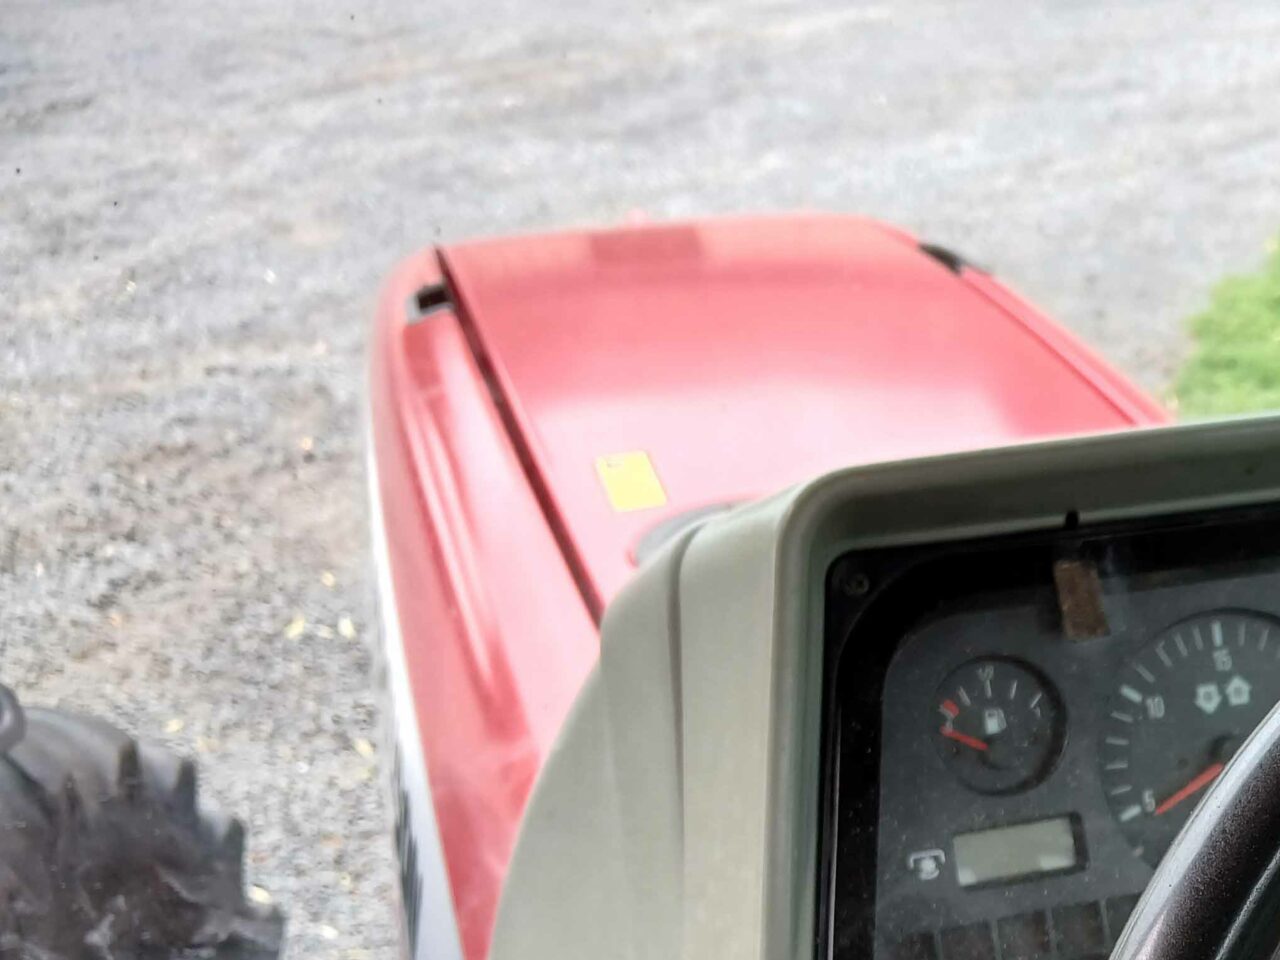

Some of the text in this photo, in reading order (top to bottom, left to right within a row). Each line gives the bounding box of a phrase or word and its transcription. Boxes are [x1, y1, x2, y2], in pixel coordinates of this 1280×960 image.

[1212, 648, 1233, 672] 15
[1146, 695, 1166, 720] 10
[1142, 789, 1157, 813] 5
